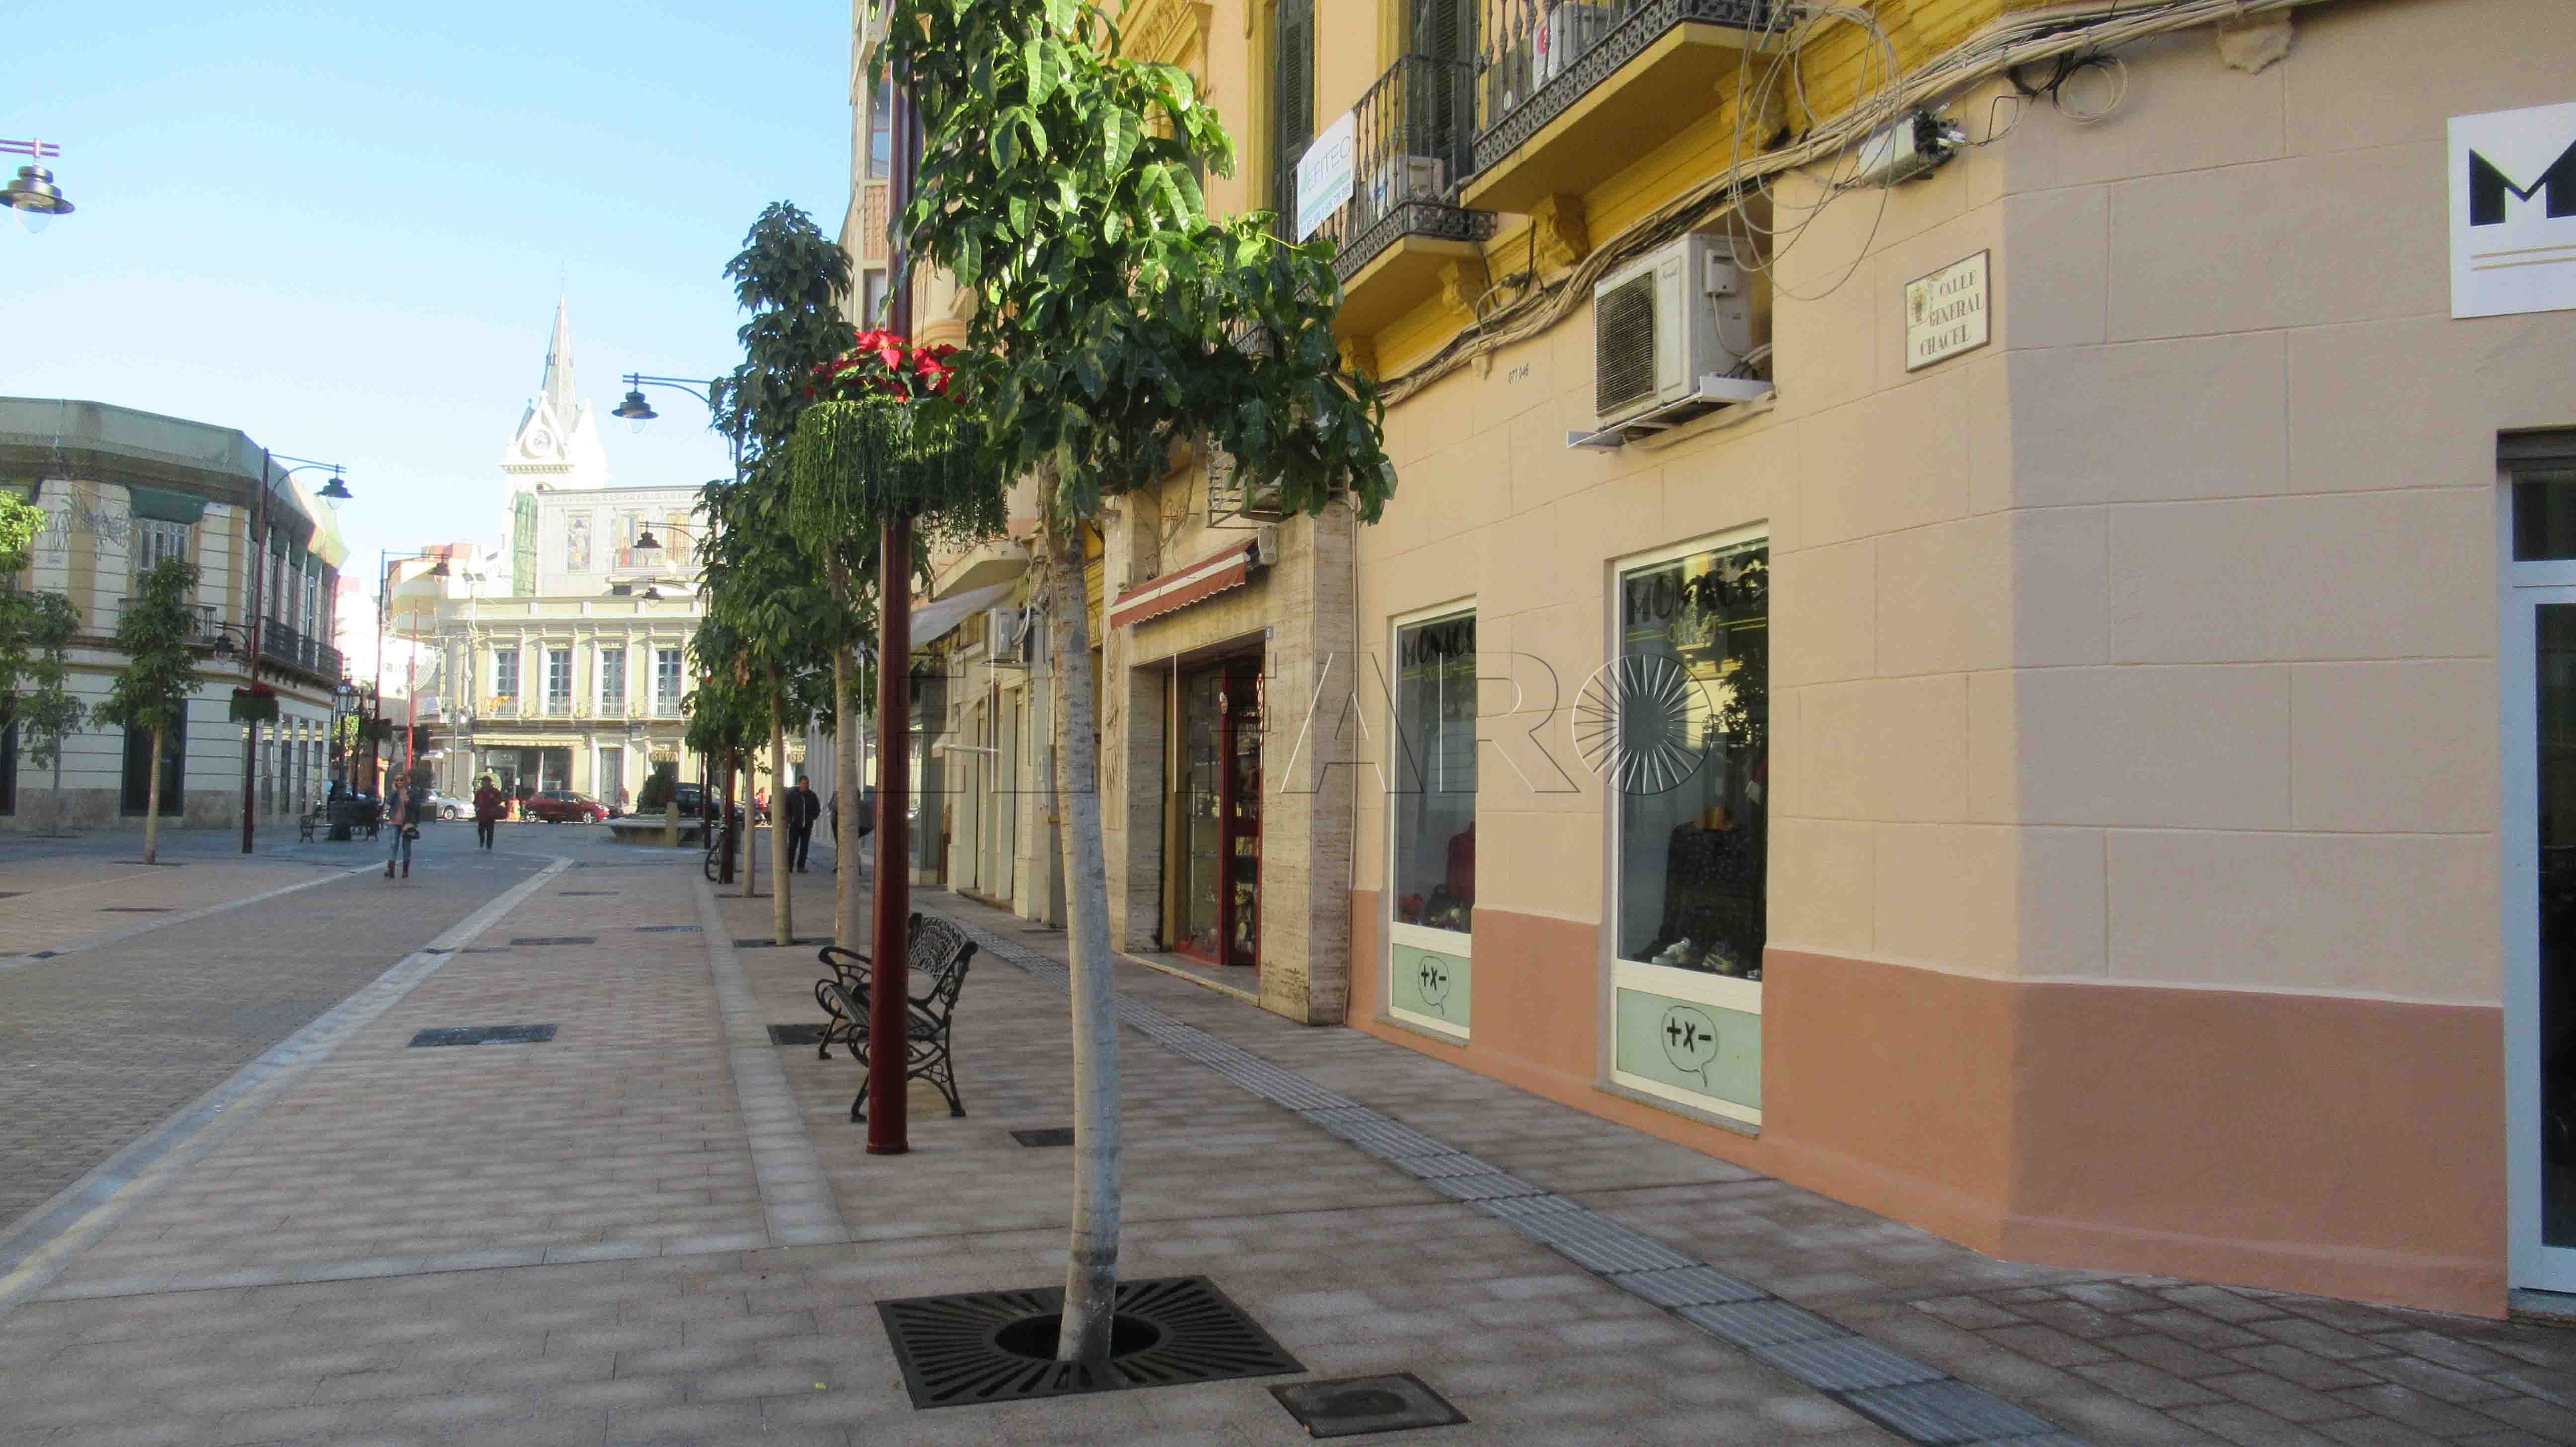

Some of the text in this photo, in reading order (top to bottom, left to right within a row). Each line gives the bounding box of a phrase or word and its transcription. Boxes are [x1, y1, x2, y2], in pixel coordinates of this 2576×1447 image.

[1939, 270, 1977, 297] CALLE
[1929, 293, 1983, 328] GENERAL
[1920, 323, 1971, 356] CHACEL
